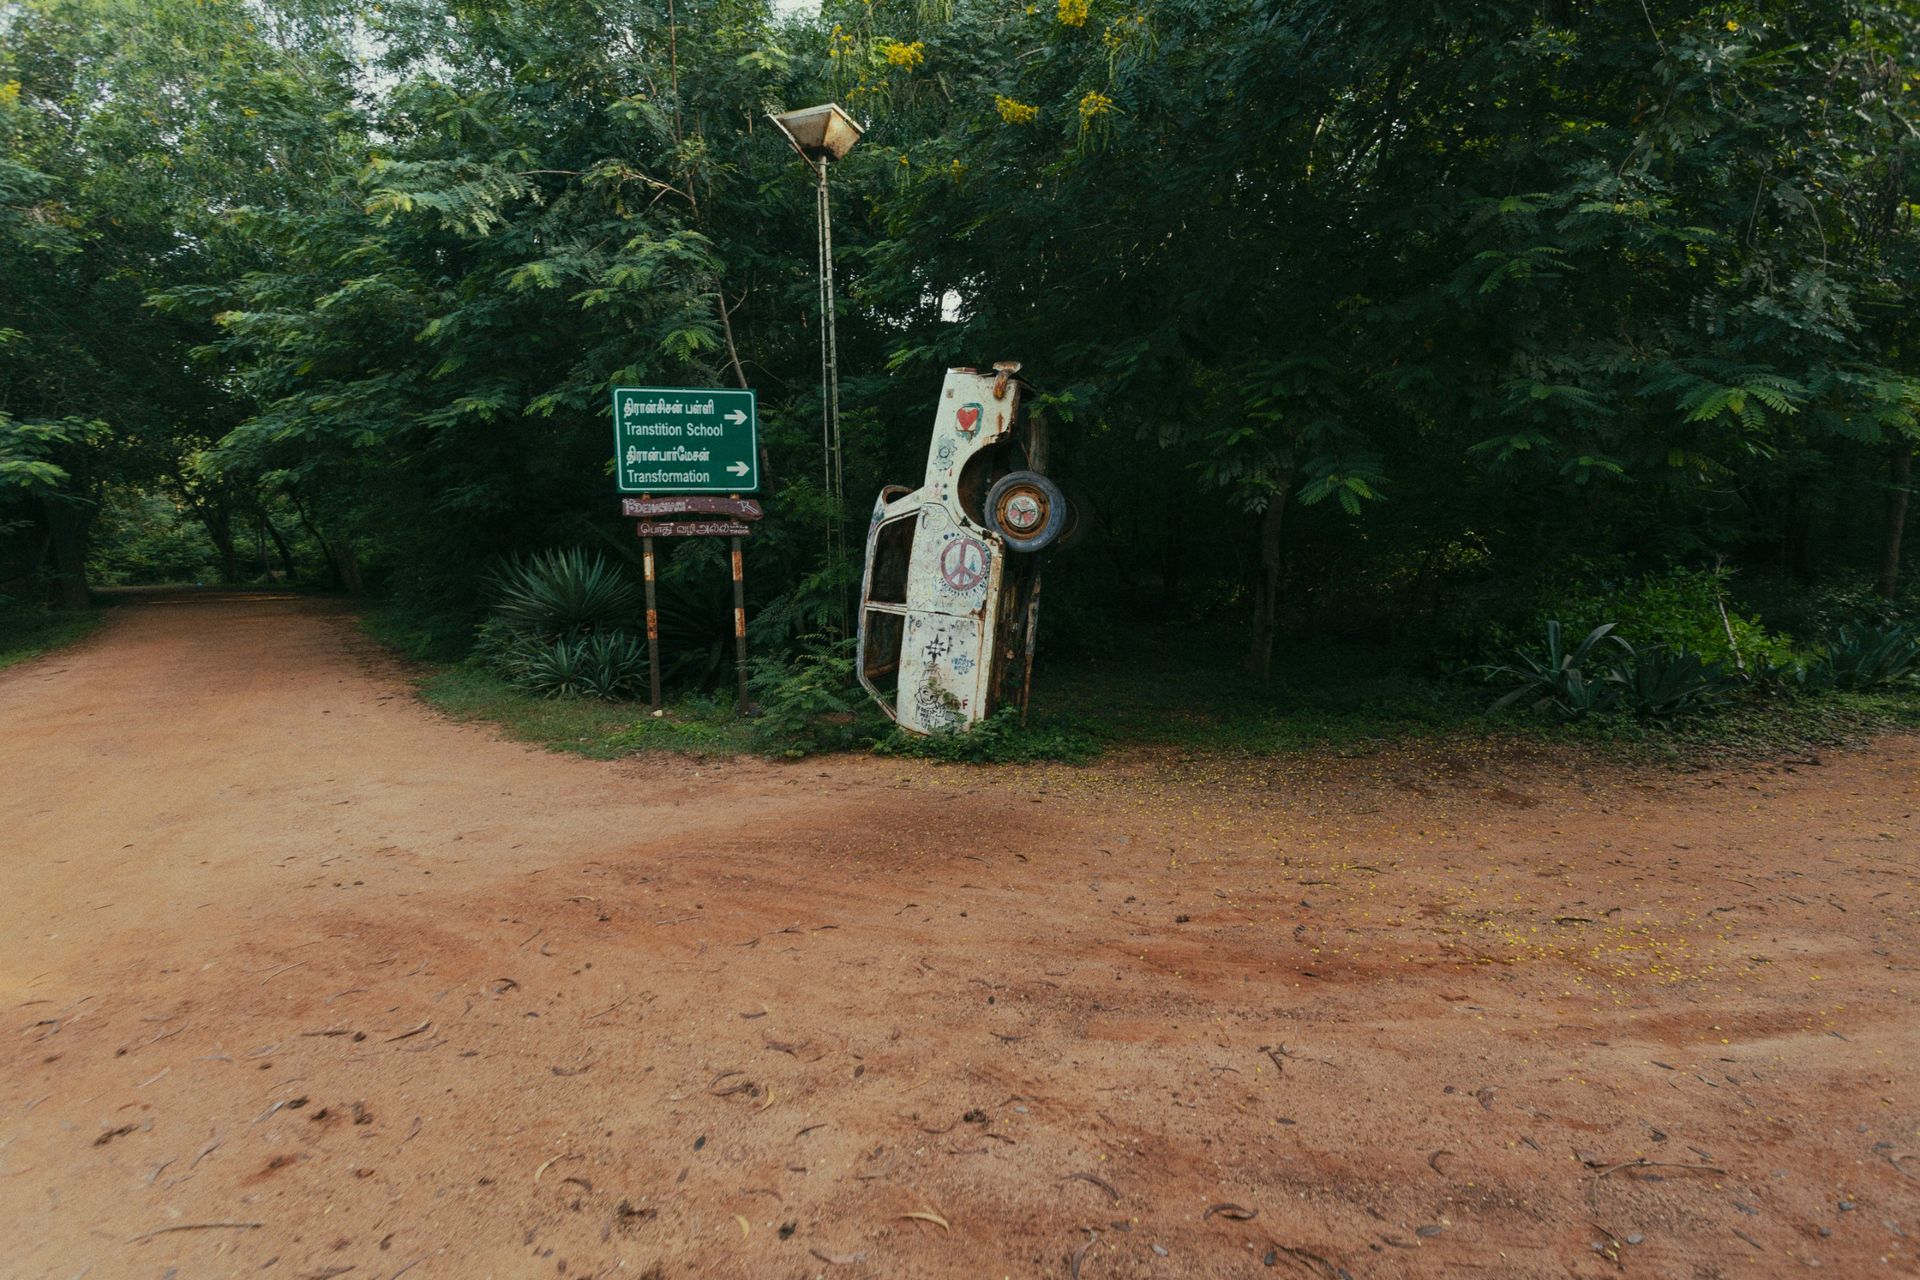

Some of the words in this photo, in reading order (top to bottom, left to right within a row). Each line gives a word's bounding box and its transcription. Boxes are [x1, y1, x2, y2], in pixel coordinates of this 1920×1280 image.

[624, 421, 682, 436] Transtition
[686, 422, 723, 437] School
[627, 469, 710, 483] Transformation
